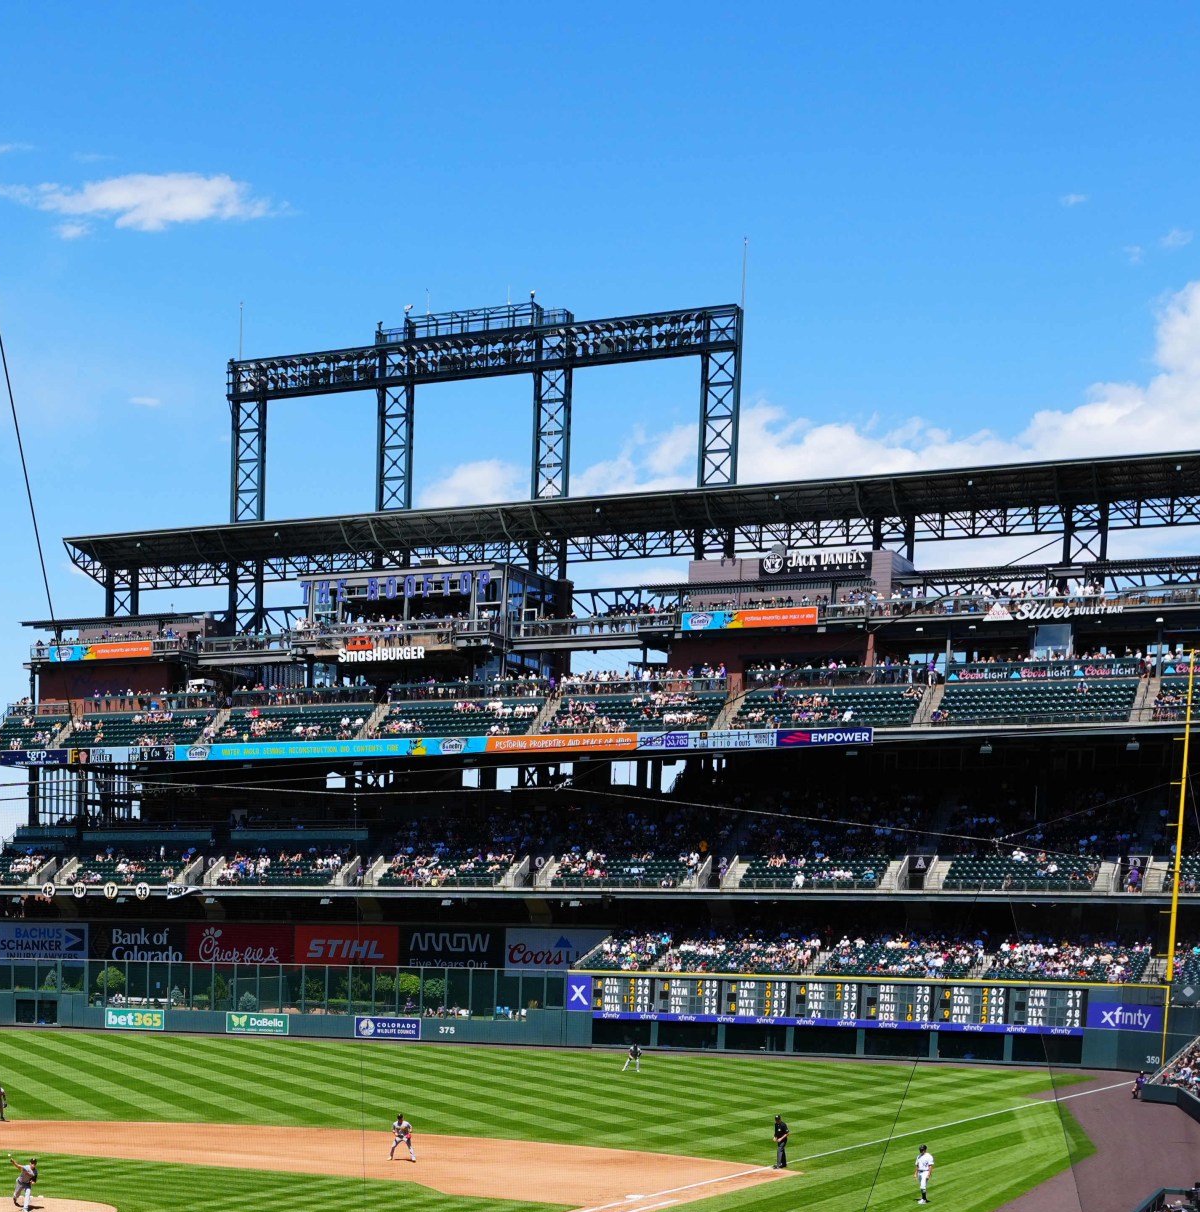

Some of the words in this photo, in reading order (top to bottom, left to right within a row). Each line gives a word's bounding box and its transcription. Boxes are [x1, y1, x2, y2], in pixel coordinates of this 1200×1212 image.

[787, 551, 817, 567] JACK
[787, 564, 864, 573] TERRACE
[1016, 603, 1072, 620] Silver
[1074, 606, 1104, 616] BULLET
[1106, 605, 1123, 614] BAR
[984, 671, 1007, 679] LIGHT
[1047, 669, 1070, 677] LIGHT
[1085, 665, 1111, 677] Coors
[1111, 667, 1135, 676] LIGHT
[811, 732, 870, 743] EMPOWER
[495, 740, 527, 750] RESTORING
[529, 738, 566, 748] PROPERTIES
[567, 738, 581, 747] AND
[26, 750, 47, 761] tgrp
[43, 886, 53, 896] 42
[106, 886, 115, 895] 17
[138, 886, 147, 896] 33
[15, 927, 62, 939] BACHUS
[112, 928, 150, 945] Bank
[153, 928, 170, 945] of
[0, 939, 62, 951] SCHANKER
[306, 939, 385, 959] STIHL
[111, 945, 183, 962] Colorado
[508, 943, 563, 965] Coors
[409, 958, 432, 967] Five
[433, 958, 464, 967] Years
[604, 977, 618, 985] ATL
[671, 979, 681, 987] SF
[740, 981, 755, 989] LAD
[604, 985, 619, 994] CIN
[808, 983, 822, 991] BAL
[880, 985, 895, 993] DET
[953, 987, 964, 995] KC
[671, 988, 688, 996] NYM
[739, 990, 748, 998] TB
[808, 992, 824, 1000] CHC
[1029, 989, 1047, 997] CHW
[604, 995, 618, 1003] MIL
[670, 997, 683, 1005] STL
[879, 994, 893, 1002] PHI
[953, 996, 969, 1004] TOR
[808, 1001, 822, 1009] ARI
[1028, 998, 1045, 1007] LAA
[604, 1004, 620, 1012] WSH
[670, 1005, 681, 1014] SD
[879, 1003, 895, 1011] HOU
[952, 1006, 970, 1014] MIN
[738, 1008, 754, 1016] MIA
[1027, 1008, 1043, 1017] TEX
[107, 1011, 162, 1027] bet365
[878, 1013, 894, 1021] BOS
[952, 1015, 966, 1023] CLE
[1101, 1006, 1152, 1029] xfinity
[250, 1018, 283, 1028] DaBella
[1027, 1018, 1043, 1026] SEA
[439, 1026, 455, 1034] 375
[1146, 1055, 1160, 1064] 350
